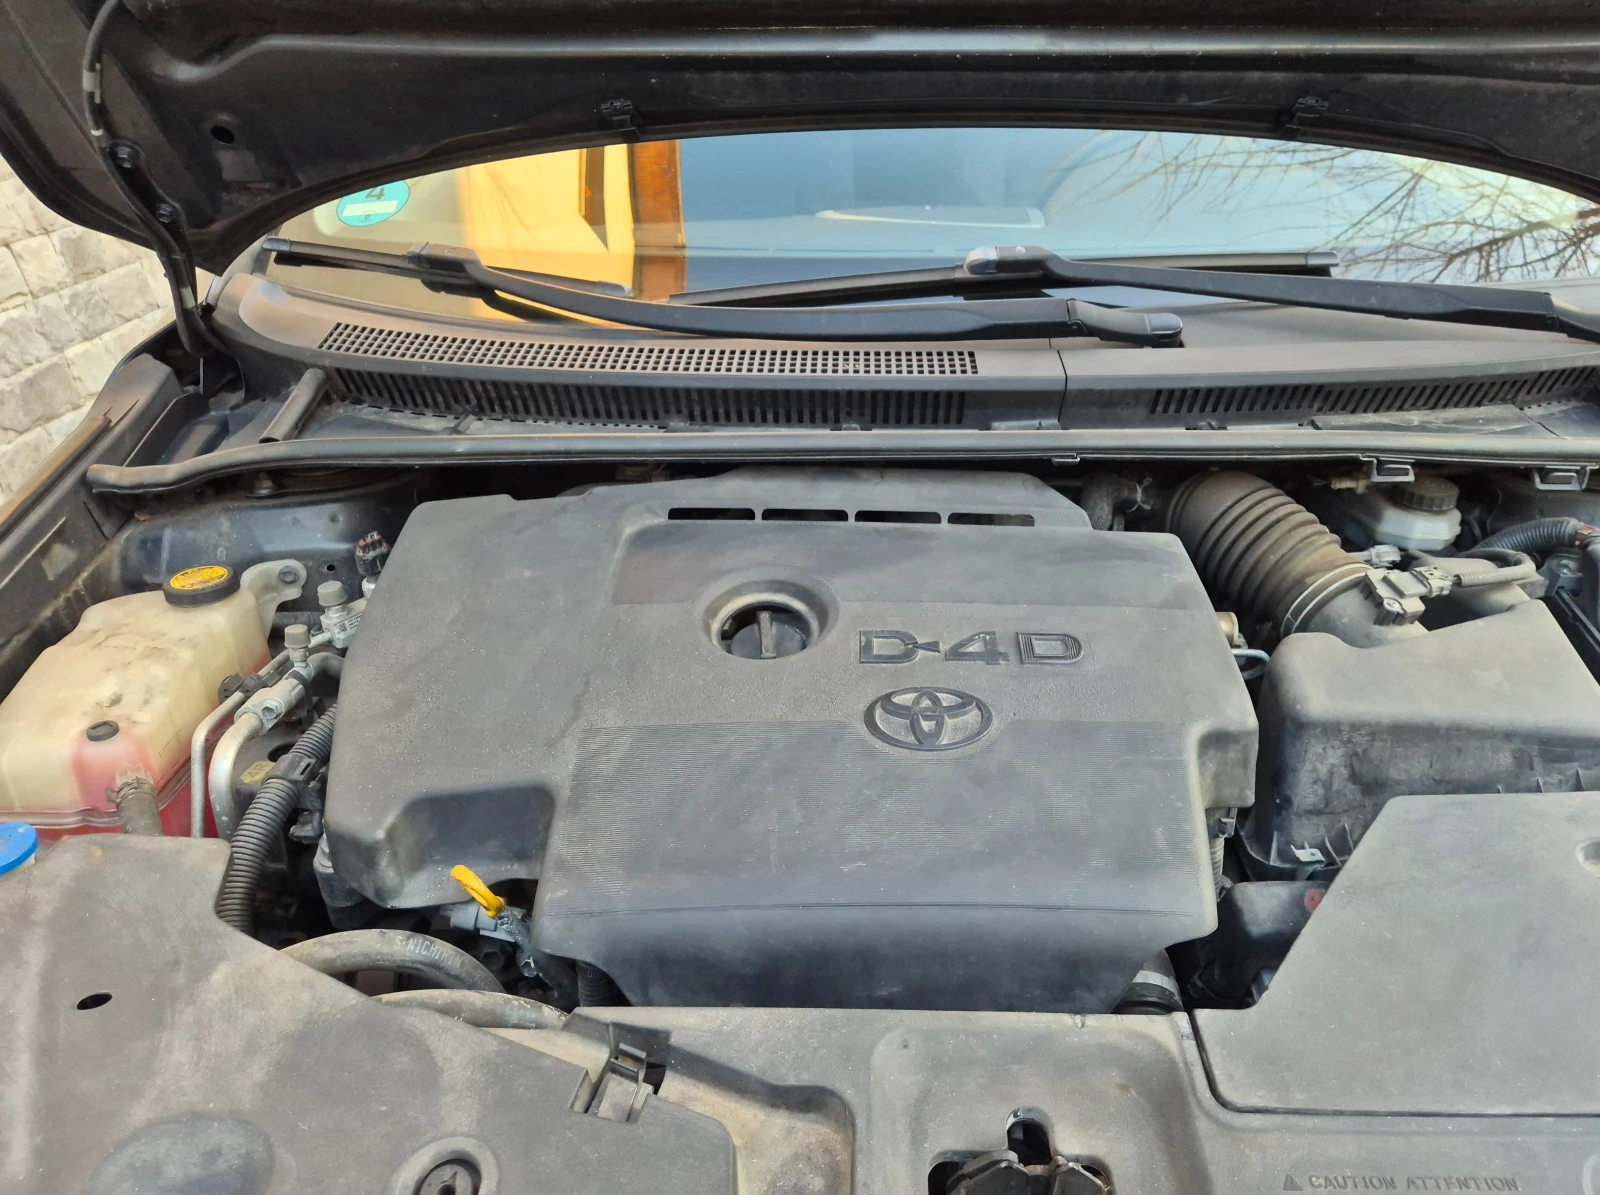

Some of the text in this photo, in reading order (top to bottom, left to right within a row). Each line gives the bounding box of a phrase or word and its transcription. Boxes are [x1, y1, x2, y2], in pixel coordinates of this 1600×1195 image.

[365, 187, 385, 200] 4
[859, 629, 1083, 665] D-4D
[1308, 1174, 1520, 1192] CAUTION ATTENTION
